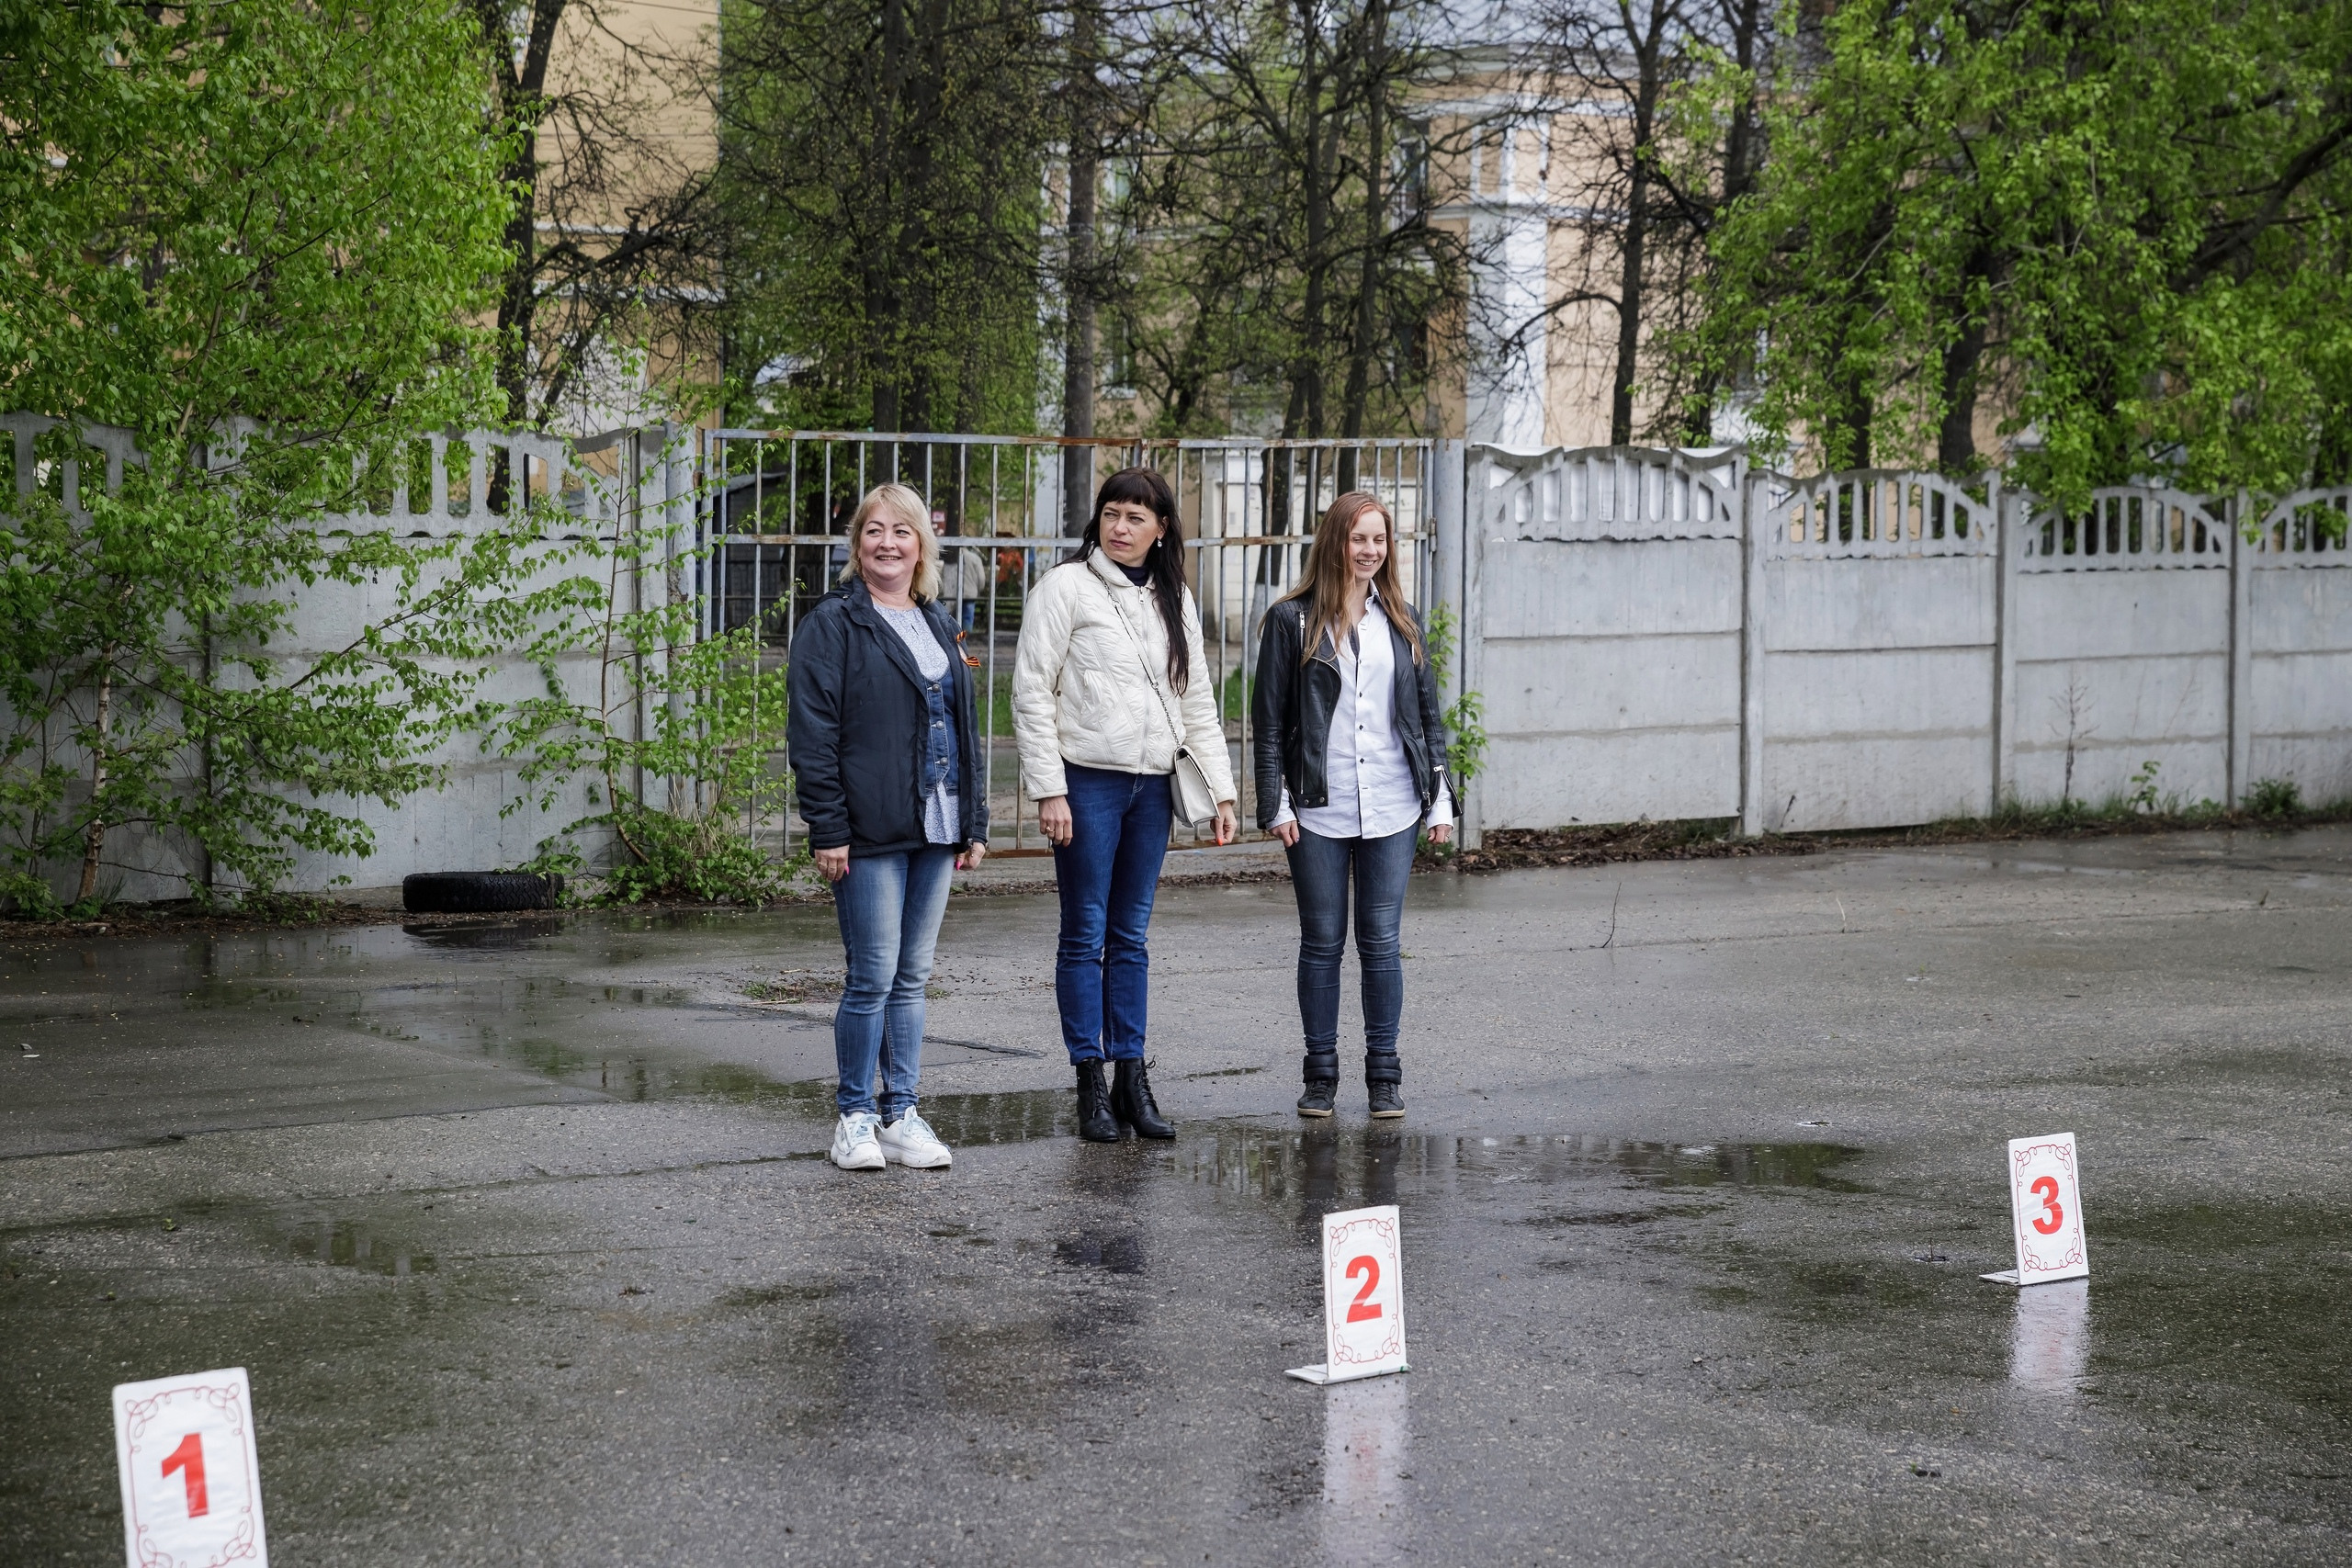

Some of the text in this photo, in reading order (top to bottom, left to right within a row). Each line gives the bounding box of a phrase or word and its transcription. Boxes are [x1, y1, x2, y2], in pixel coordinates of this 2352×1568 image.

[2030, 1176, 2064, 1235] 3
[1345, 1255, 1383, 1324] 2
[161, 1432, 209, 1518] 1
